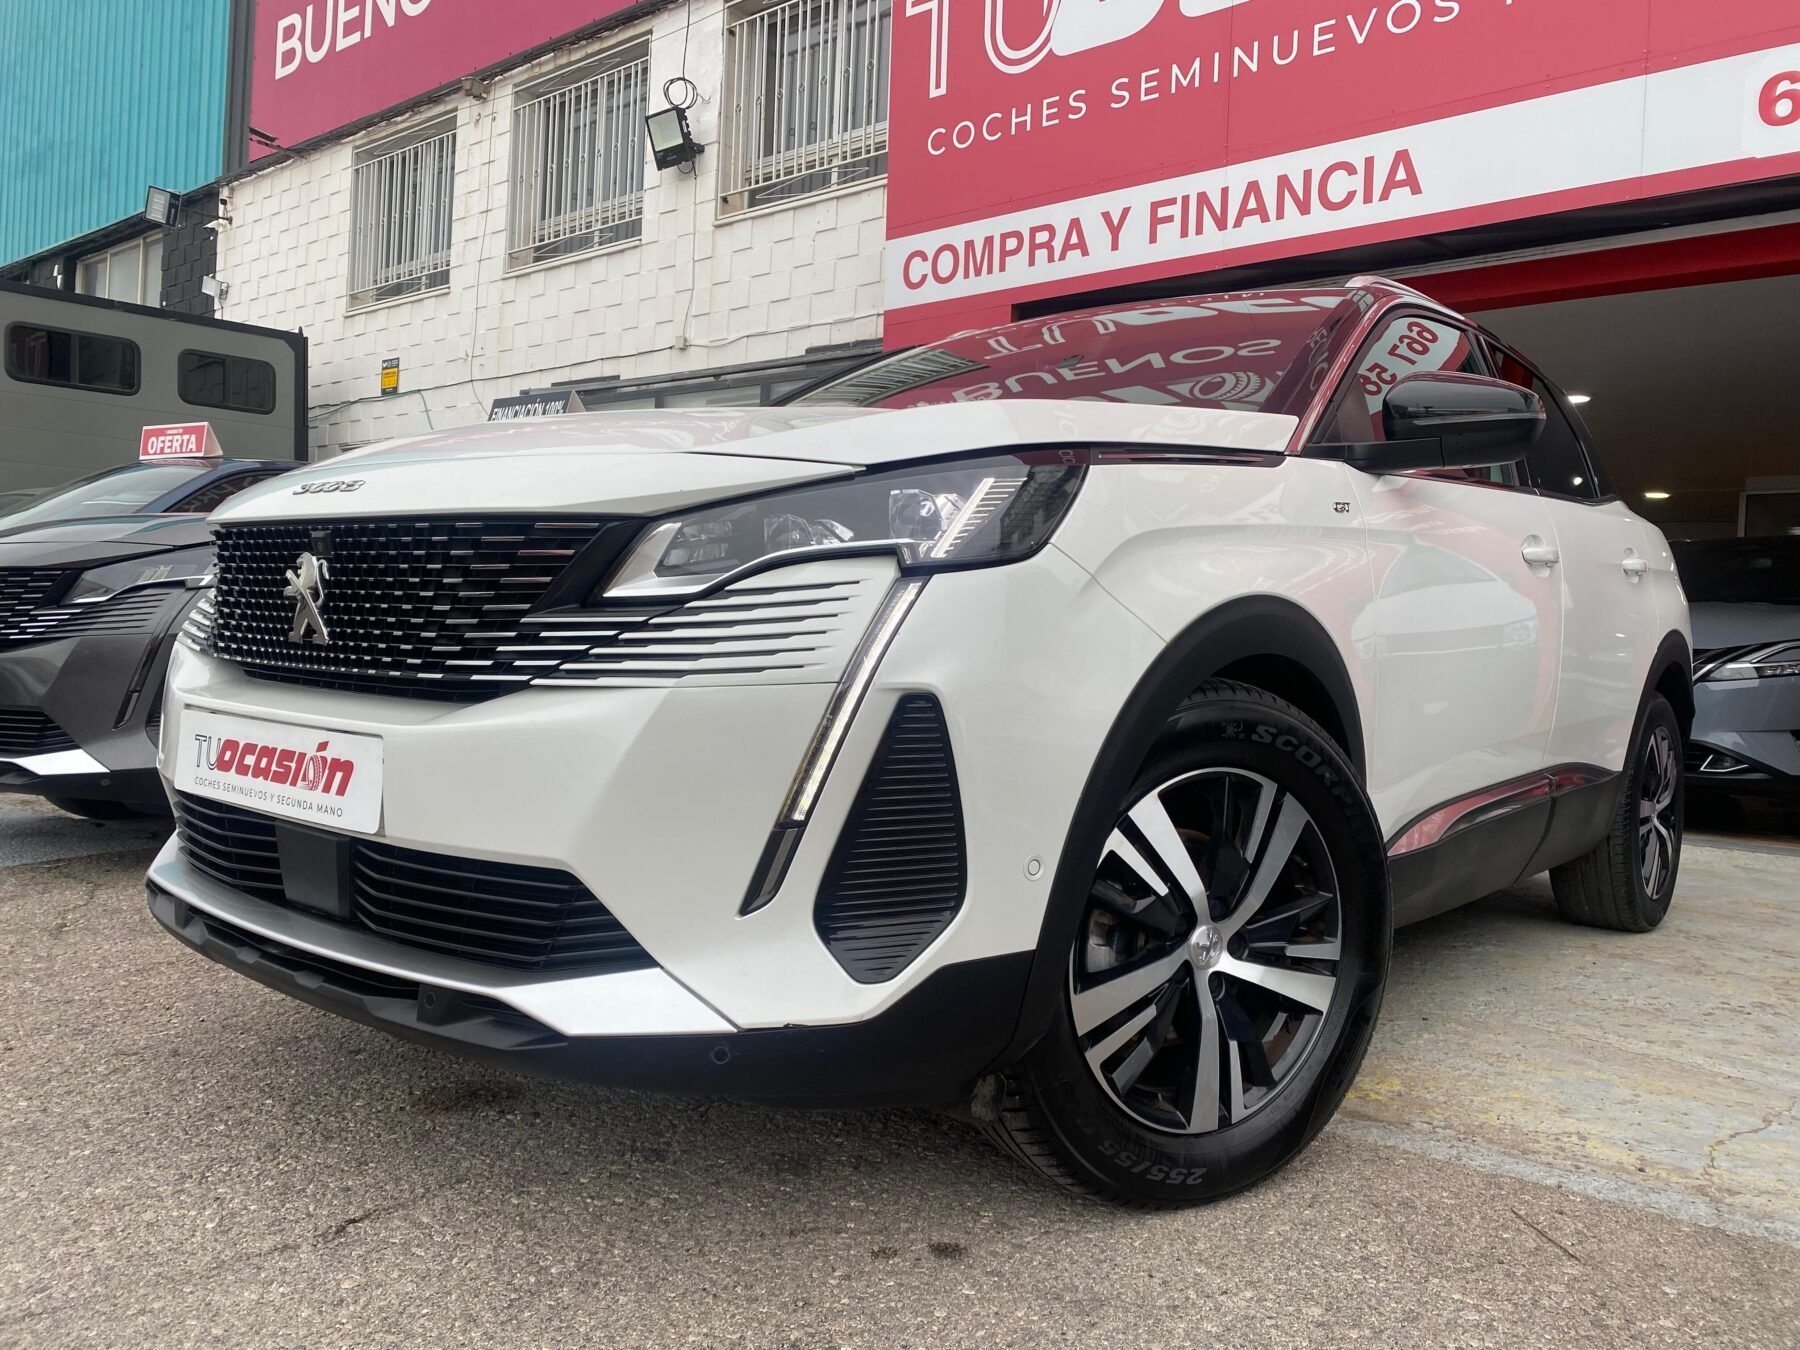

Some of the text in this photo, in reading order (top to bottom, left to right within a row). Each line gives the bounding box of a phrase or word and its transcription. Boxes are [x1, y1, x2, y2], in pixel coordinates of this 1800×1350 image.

[275, 0, 431, 80] BUEN
[927, 0, 1460, 155] COCHES SEMINUEVOS
[903, 217, 1090, 291] COMPRA
[1101, 206, 1132, 252] Y
[1149, 148, 1423, 245] FINANCIA
[490, 399, 566, 421] FINANCIACIÓN 100%
[147, 434, 197, 454] OFERTA
[292, 479, 366, 495] 3008
[1333, 501, 1350, 513] GT
[195, 776, 343, 817] COCHES SEMINUEVOS Y SEGUNDA MANO
